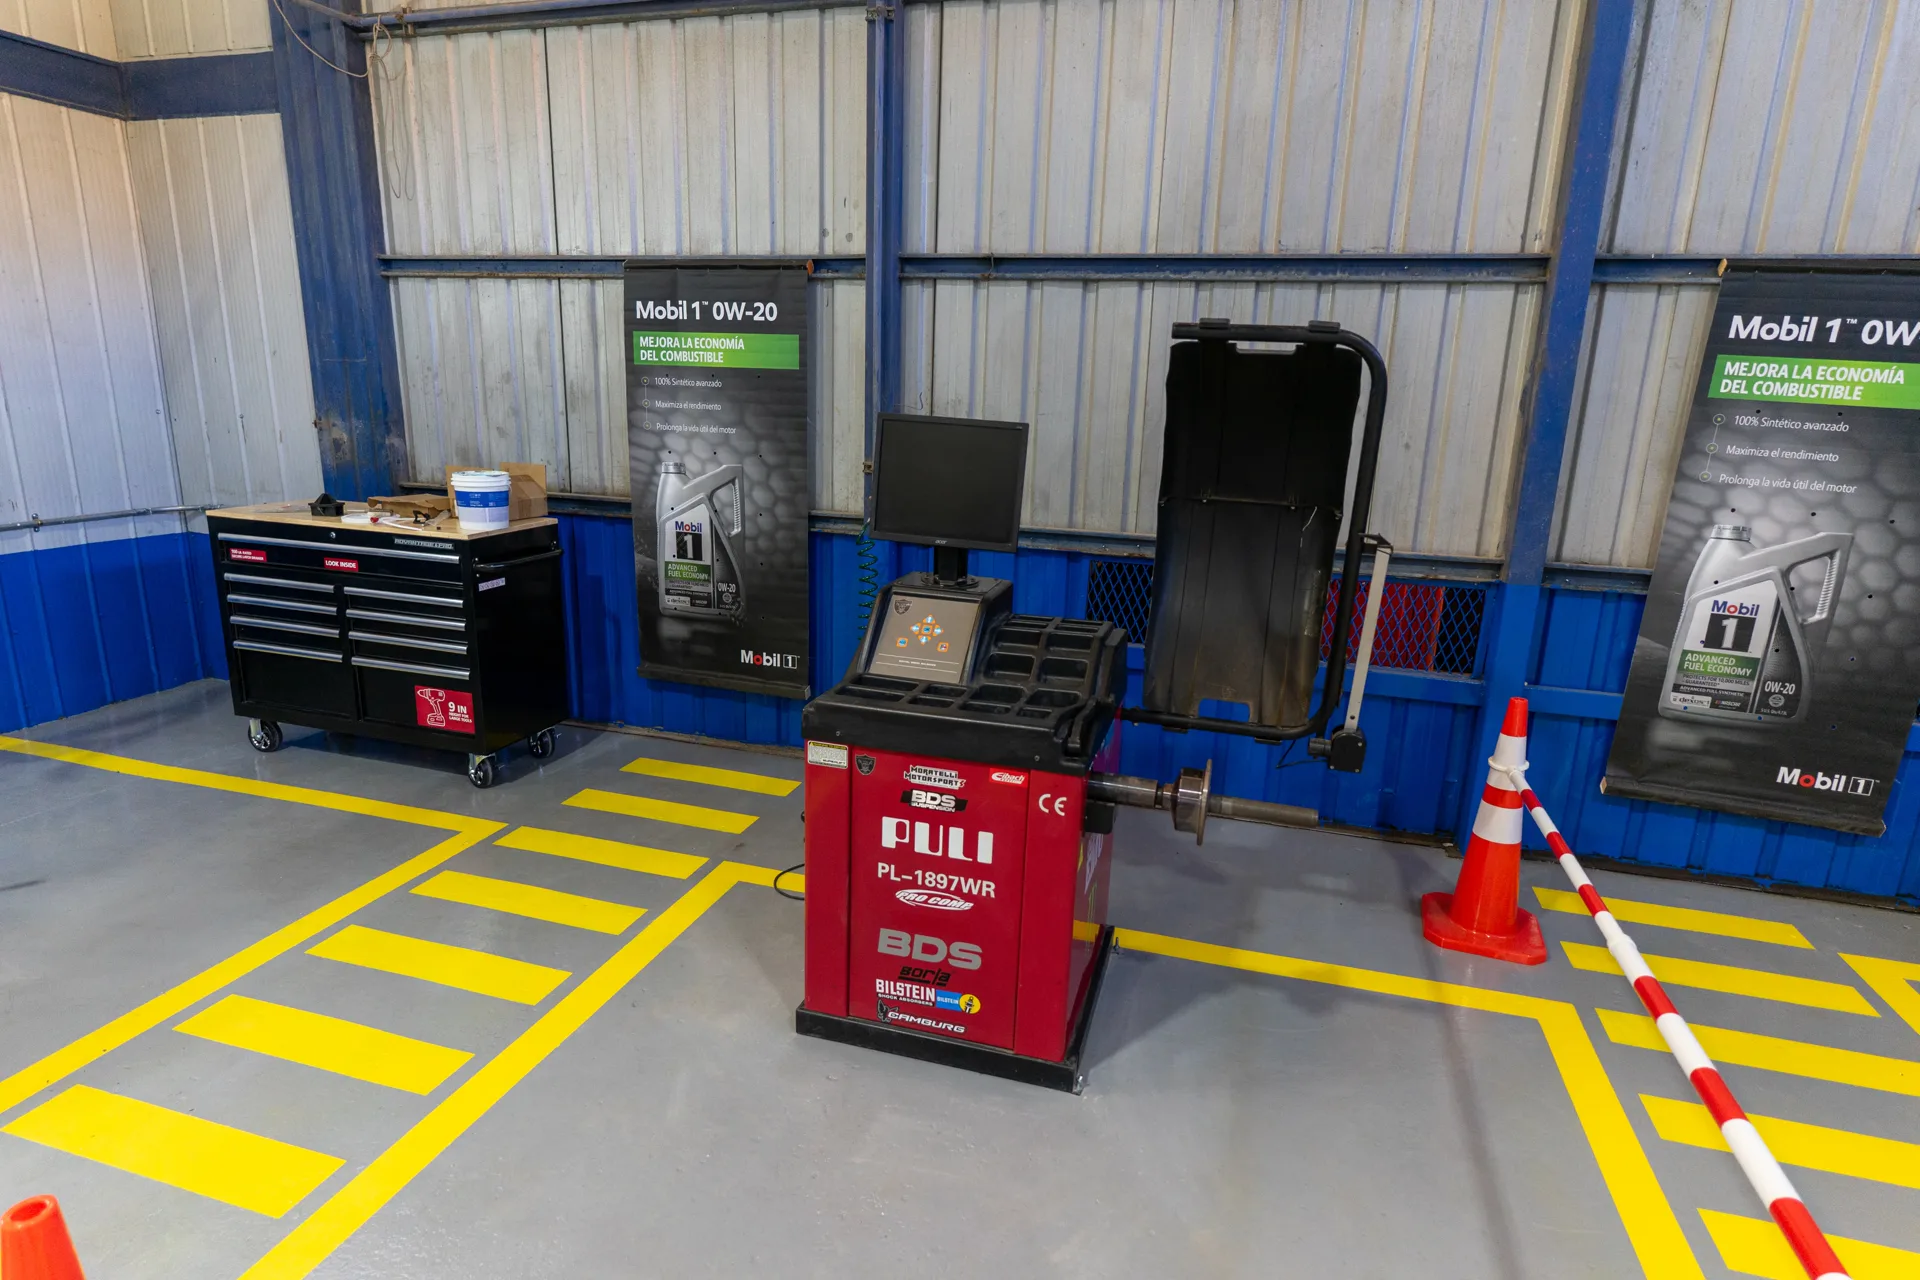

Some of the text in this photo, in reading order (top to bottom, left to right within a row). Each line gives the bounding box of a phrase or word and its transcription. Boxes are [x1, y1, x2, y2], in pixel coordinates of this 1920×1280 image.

[636, 300, 687, 320] Mobil
[712, 301, 778, 321] 0W-20
[1728, 315, 1818, 342] Mobil
[1861, 319, 1920, 346] 0W
[640, 335, 744, 350] MEJORA LA ECONOMÍA
[640, 350, 723, 363] DEL COMBUSTIBLE
[1724, 361, 1904, 384] MEJORA LA ECONOMÍA
[655, 377, 722, 388] 100% Sintético avanzado
[1720, 379, 1864, 400] DEL COMBUSTIBLE
[655, 401, 721, 411] Maximiza el rendimiento
[656, 422, 682, 433] Prolonga
[683, 424, 688, 432] la
[709, 425, 718, 433] del
[719, 426, 736, 434] motor
[1734, 415, 1849, 432] 100% Sintético avanzado
[1726, 445, 1839, 462] Maximiza el rendimiento
[1719, 473, 1857, 494] Prolonga la vida útil del motor
[675, 521, 702, 533] Mobil
[668, 563, 697, 572] ADVANCED
[683, 571, 708, 580] ECONOMY
[718, 582, 736, 592] 0W-20
[1711, 600, 1760, 617] Mobil
[741, 649, 780, 667] Mobil
[1685, 652, 1736, 666] ADVANCED
[1684, 661, 1752, 677] FUEL ECONOMY
[1764, 681, 1795, 694] 0W-20
[448, 701, 467, 714] 9 IN
[910, 765, 958, 779] MORATELLI
[1776, 766, 1847, 792] Mobil
[910, 801, 955, 812] SUSPENSION
[911, 789, 956, 808] BDS
[1039, 793, 1067, 816] CE
[881, 816, 993, 864] PULI
[877, 862, 996, 898] PL-1897WR
[897, 891, 974, 909] PRO COMP
[877, 928, 983, 969] BDS
[876, 978, 935, 1002] BILSTEIN
